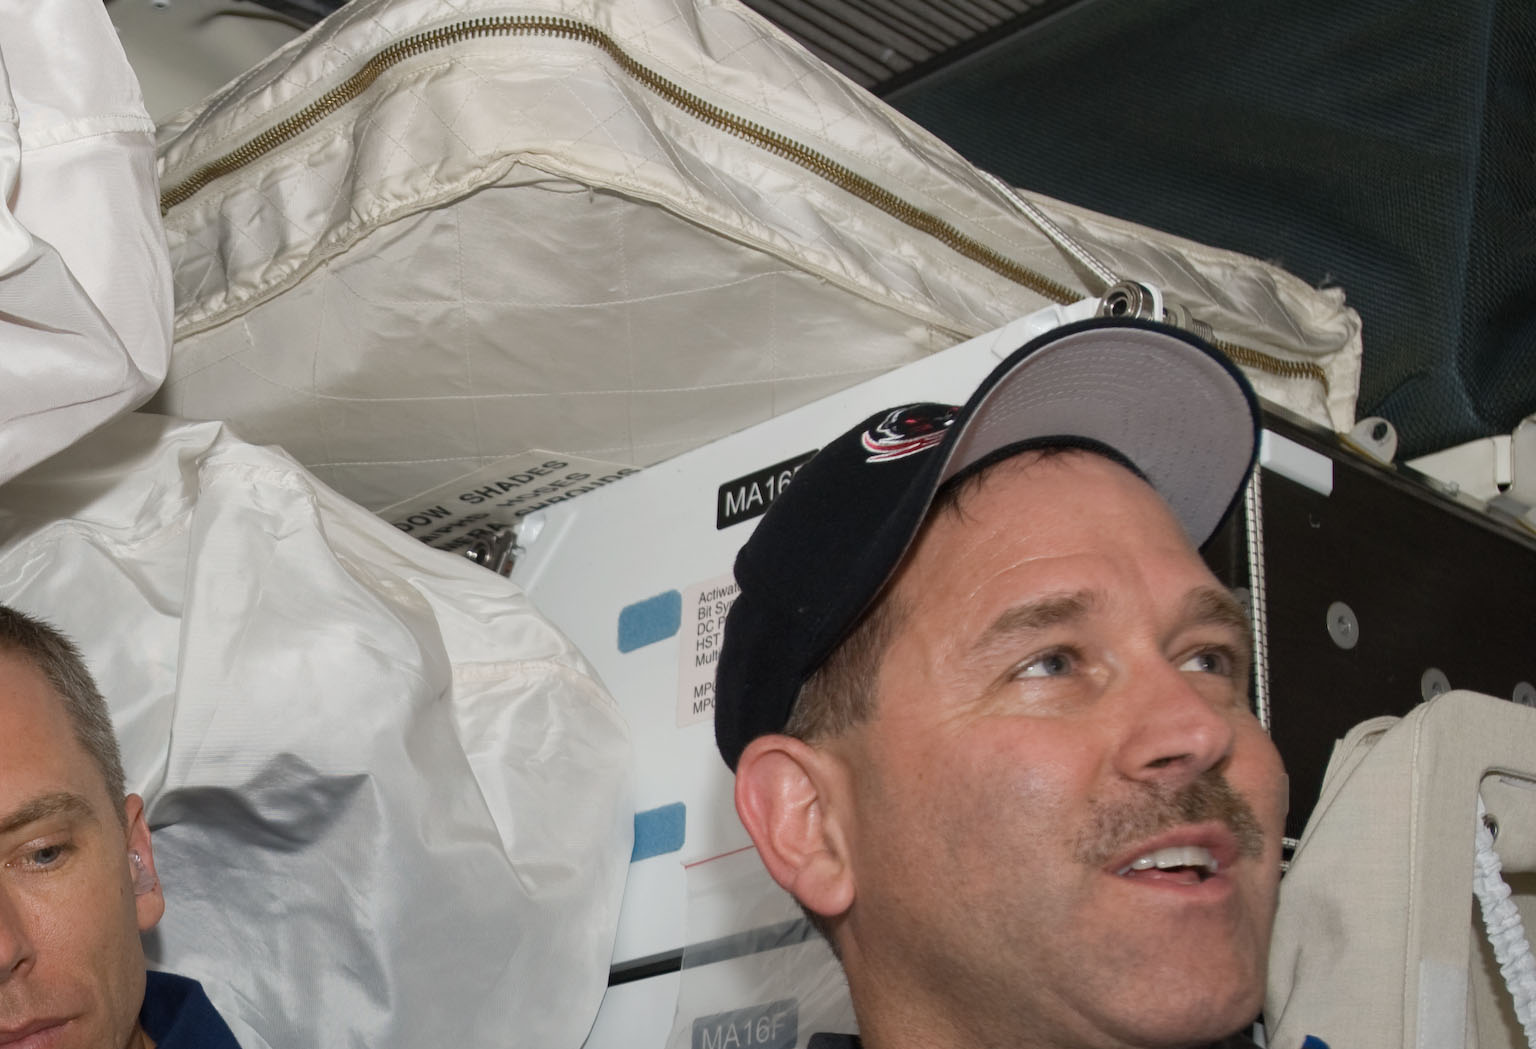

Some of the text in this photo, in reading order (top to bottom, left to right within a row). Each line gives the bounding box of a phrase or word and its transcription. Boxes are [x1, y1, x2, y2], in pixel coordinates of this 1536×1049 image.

[459, 460, 568, 504] SHADES
[698, 605, 712, 621] Bit
[697, 620, 714, 636] DC
[696, 633, 721, 651] HST
